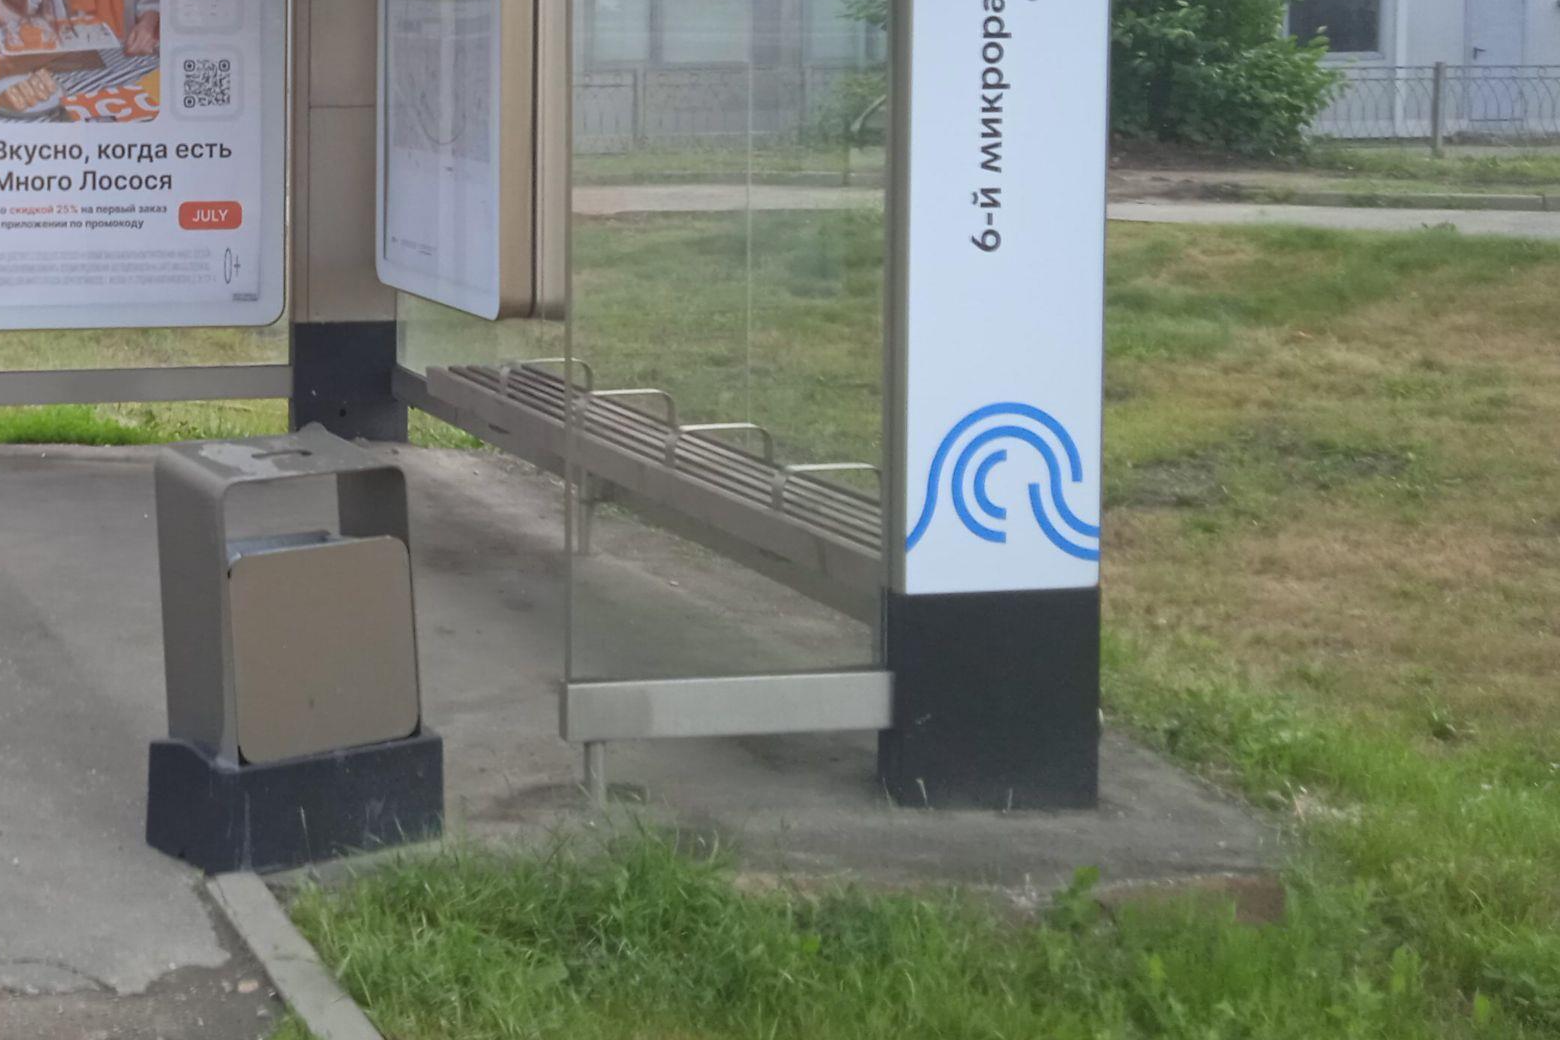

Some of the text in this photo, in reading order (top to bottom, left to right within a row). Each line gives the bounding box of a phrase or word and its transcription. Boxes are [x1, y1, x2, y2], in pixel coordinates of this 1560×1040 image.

[97, 142, 168, 163] когда
[175, 142, 232, 159] есть
[79, 170, 172, 191] Лосося
[9, 204, 54, 216] скидкой
[56, 204, 79, 214] 25%
[80, 205, 93, 214] на
[96, 203, 136, 216] первый
[138, 204, 167, 213] заказ
[193, 208, 228, 223] JULY
[1, 219, 67, 230] приложении
[70, 219, 82, 228] по
[85, 218, 144, 230] промокоду
[971, 187, 1002, 253] 6-й
